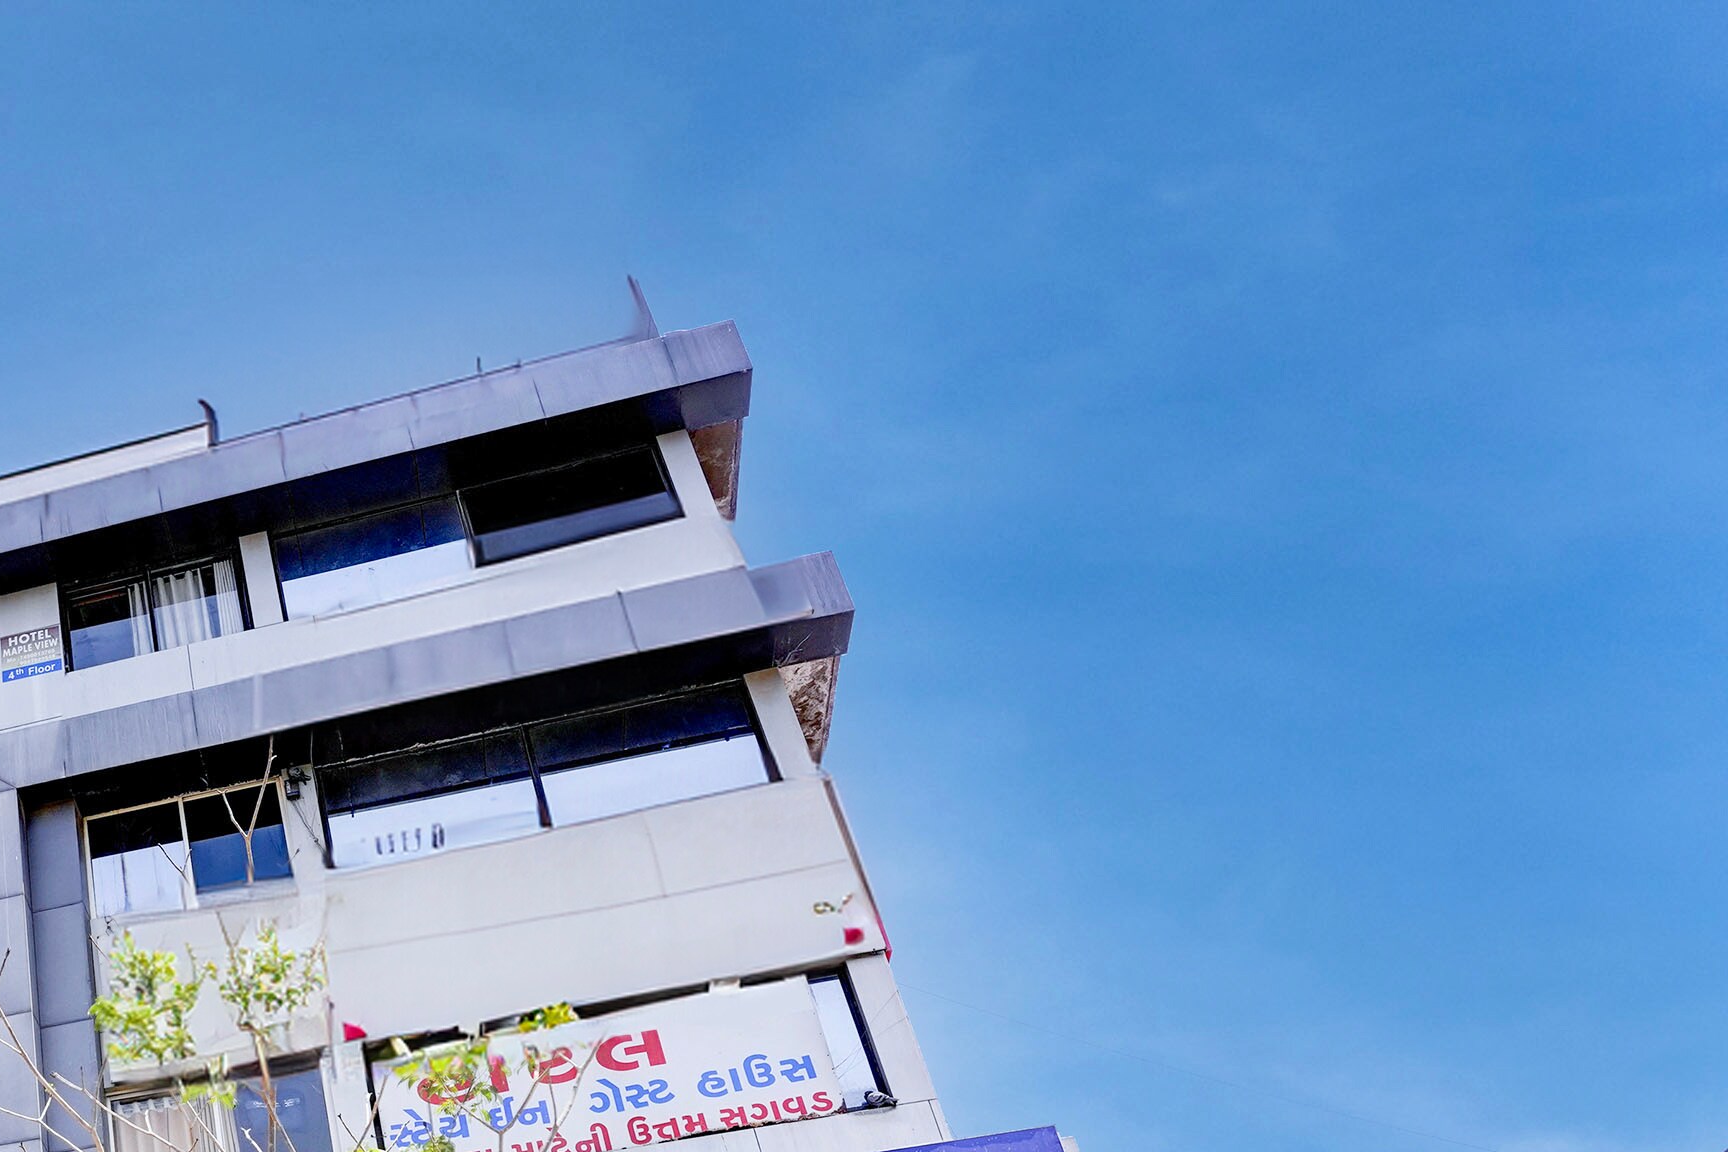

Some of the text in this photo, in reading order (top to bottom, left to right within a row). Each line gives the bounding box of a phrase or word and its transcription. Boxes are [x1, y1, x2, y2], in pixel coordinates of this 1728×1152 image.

[2, 643, 33, 658] MAPLE
[34, 637, 58, 650] VIEW
[8, 629, 52, 647] HOTEL
[8, 663, 56, 680] 4th Floor
[697, 1054, 817, 1098] હાઉસ
[719, 1091, 834, 1127] સગવડ
